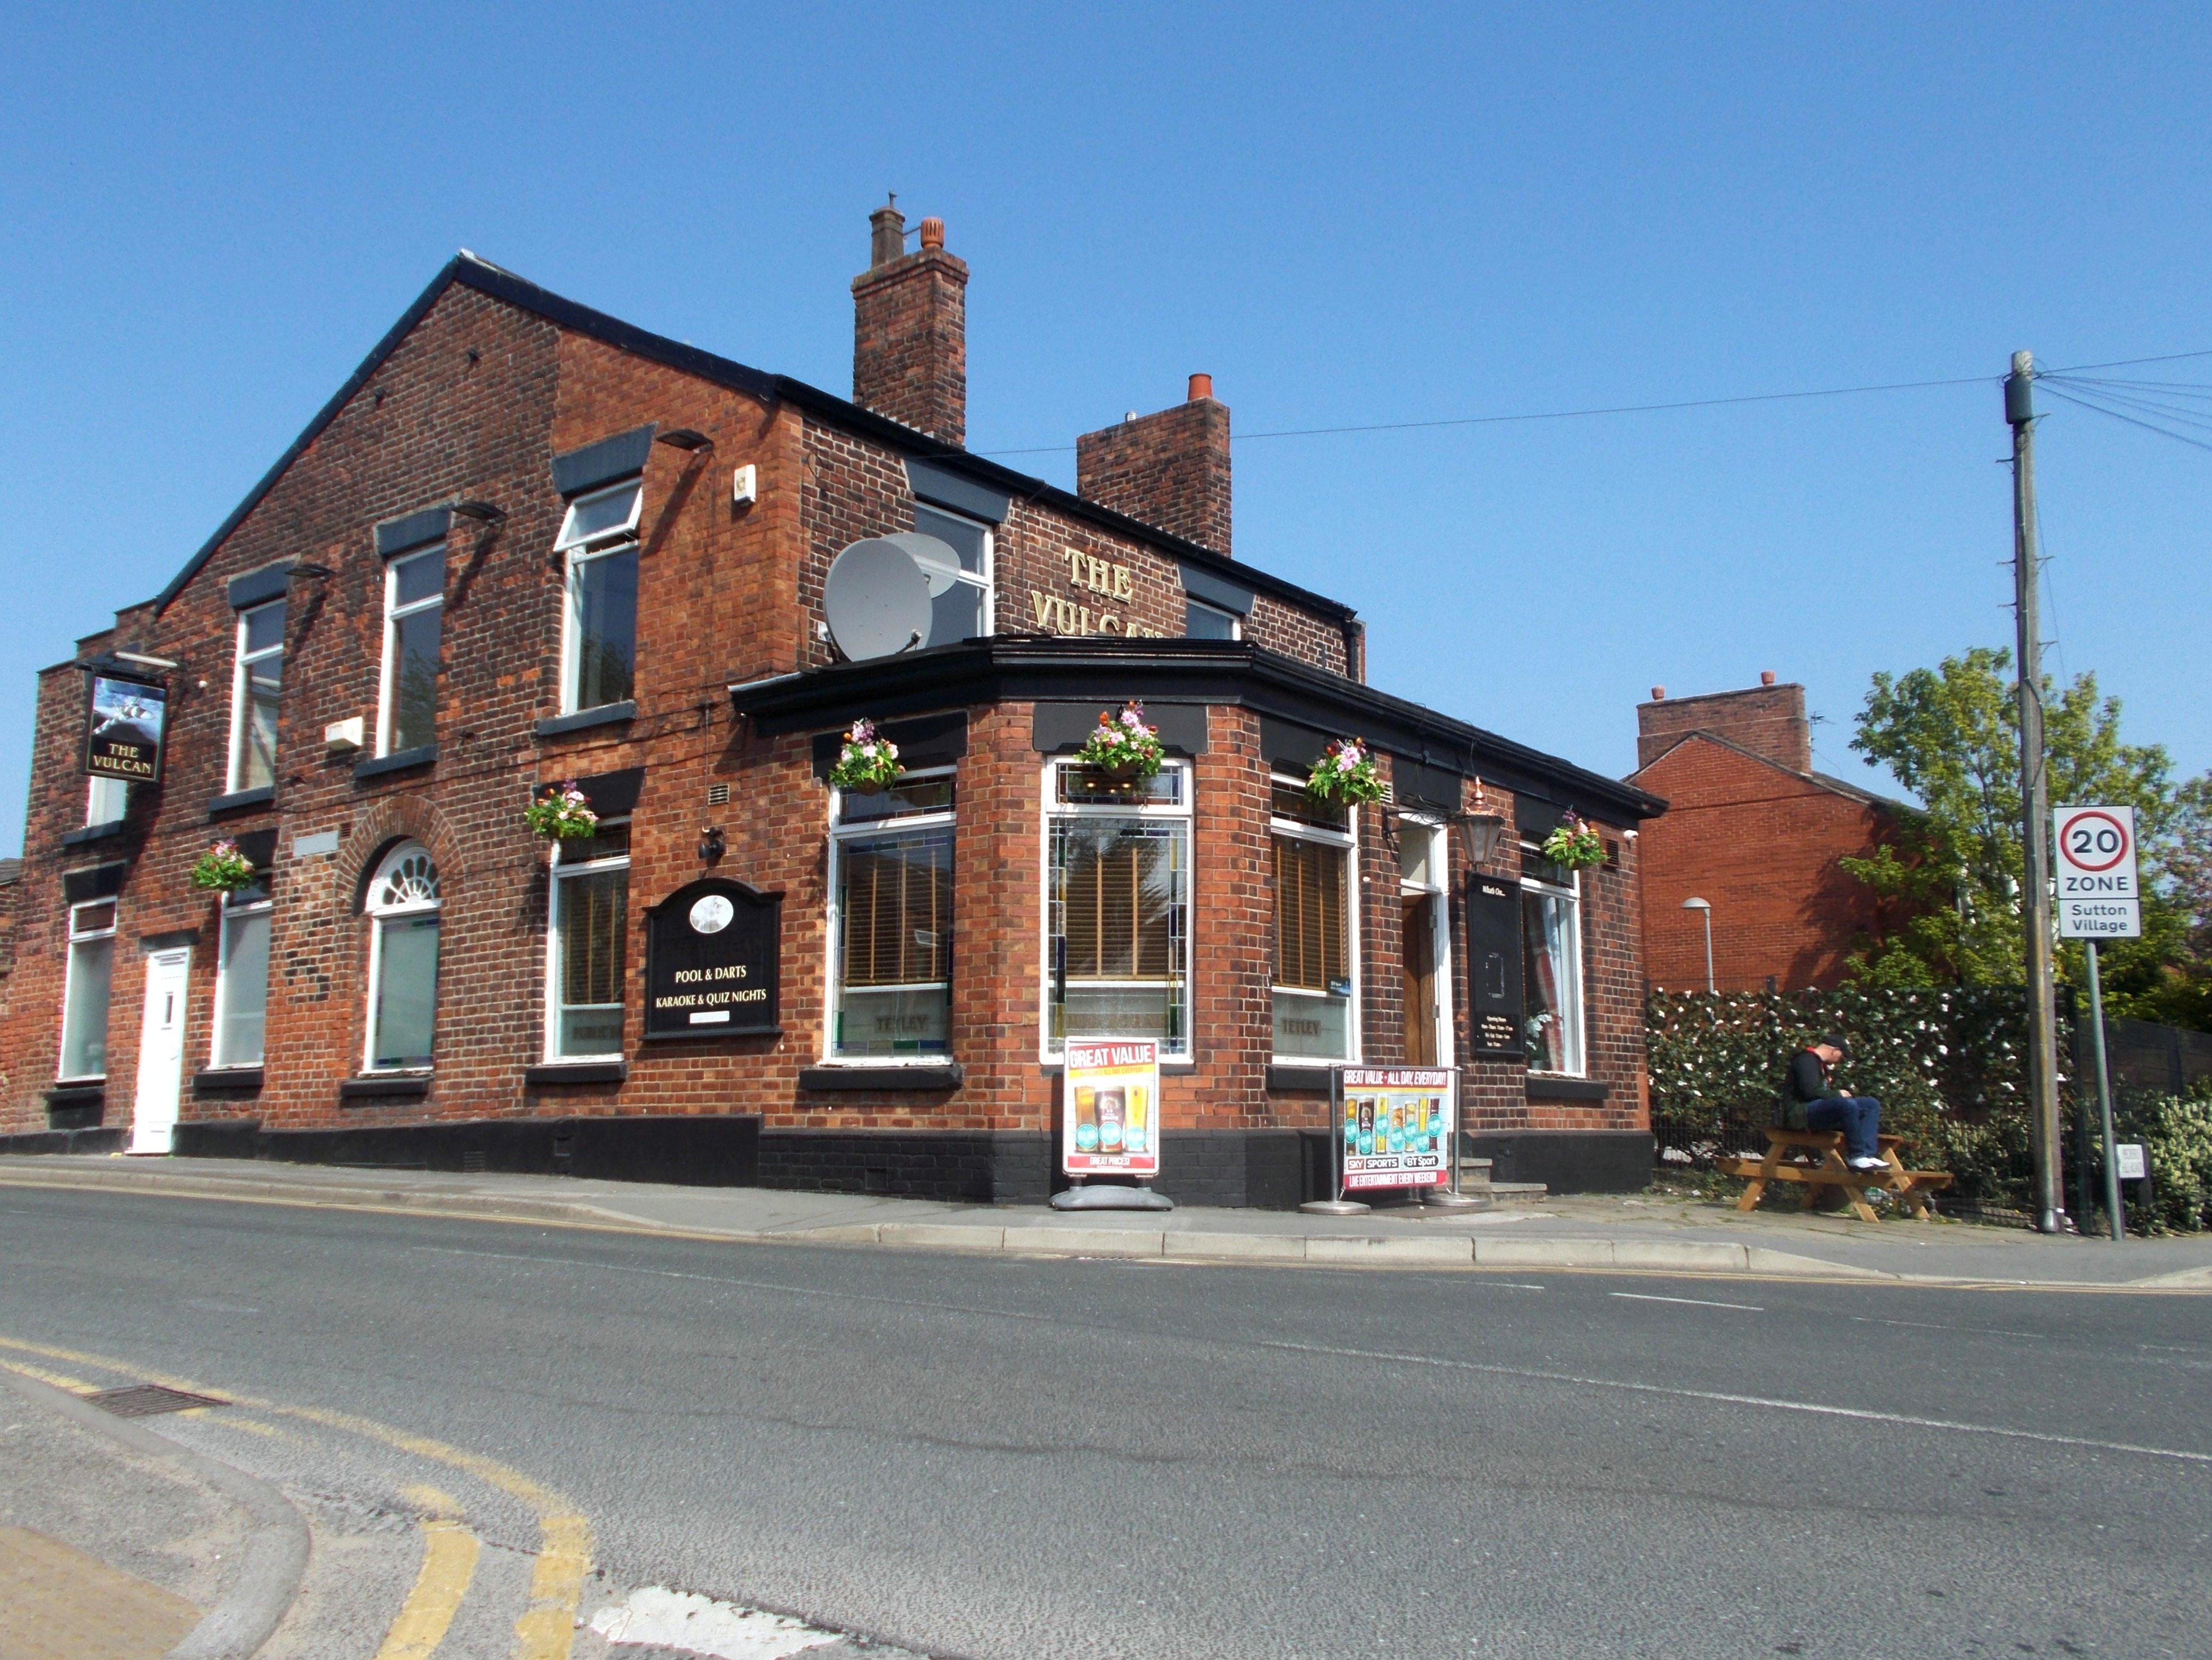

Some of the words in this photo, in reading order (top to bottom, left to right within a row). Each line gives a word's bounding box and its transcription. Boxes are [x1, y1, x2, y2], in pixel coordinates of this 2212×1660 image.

[1065, 546, 1133, 605] THE
[1031, 589, 1164, 638] VULC
[109, 743, 139, 758] THE
[93, 754, 152, 774] VULCAN
[2072, 829, 2119, 853] 20
[2066, 876, 2129, 891] ZONE
[2072, 905, 2127, 916] Sutton
[2072, 919, 2128, 933] Village
[675, 969, 703, 984] POOL
[705, 968, 713, 980] &
[715, 965, 747, 979] DARTS
[656, 994, 696, 1008] KARAOKE
[697, 994, 705, 1005] &
[706, 992, 730, 1006] QUIZ
[732, 988, 767, 1003] NIGHTS
[1069, 1048, 1109, 1068] GREAT
[1111, 1045, 1152, 1065] VALUE
[1344, 1069, 1364, 1084] GREAT
[1365, 1070, 1384, 1084] VALUE
[1387, 1071, 1401, 1084] ALL
[1401, 1071, 1413, 1087] DAY,
[1414, 1071, 1447, 1085] EVERYDAY!
[1348, 1160, 1364, 1169] SKY
[1367, 1159, 1398, 1168] SPORTS
[1407, 1157, 1418, 1166] BT
[1418, 1155, 1436, 1167] Sport
[1349, 1176, 1359, 1187] LIVE
[1359, 1172, 1398, 1186] ENTERTAINMENT
[1399, 1172, 1414, 1185] EVERY
